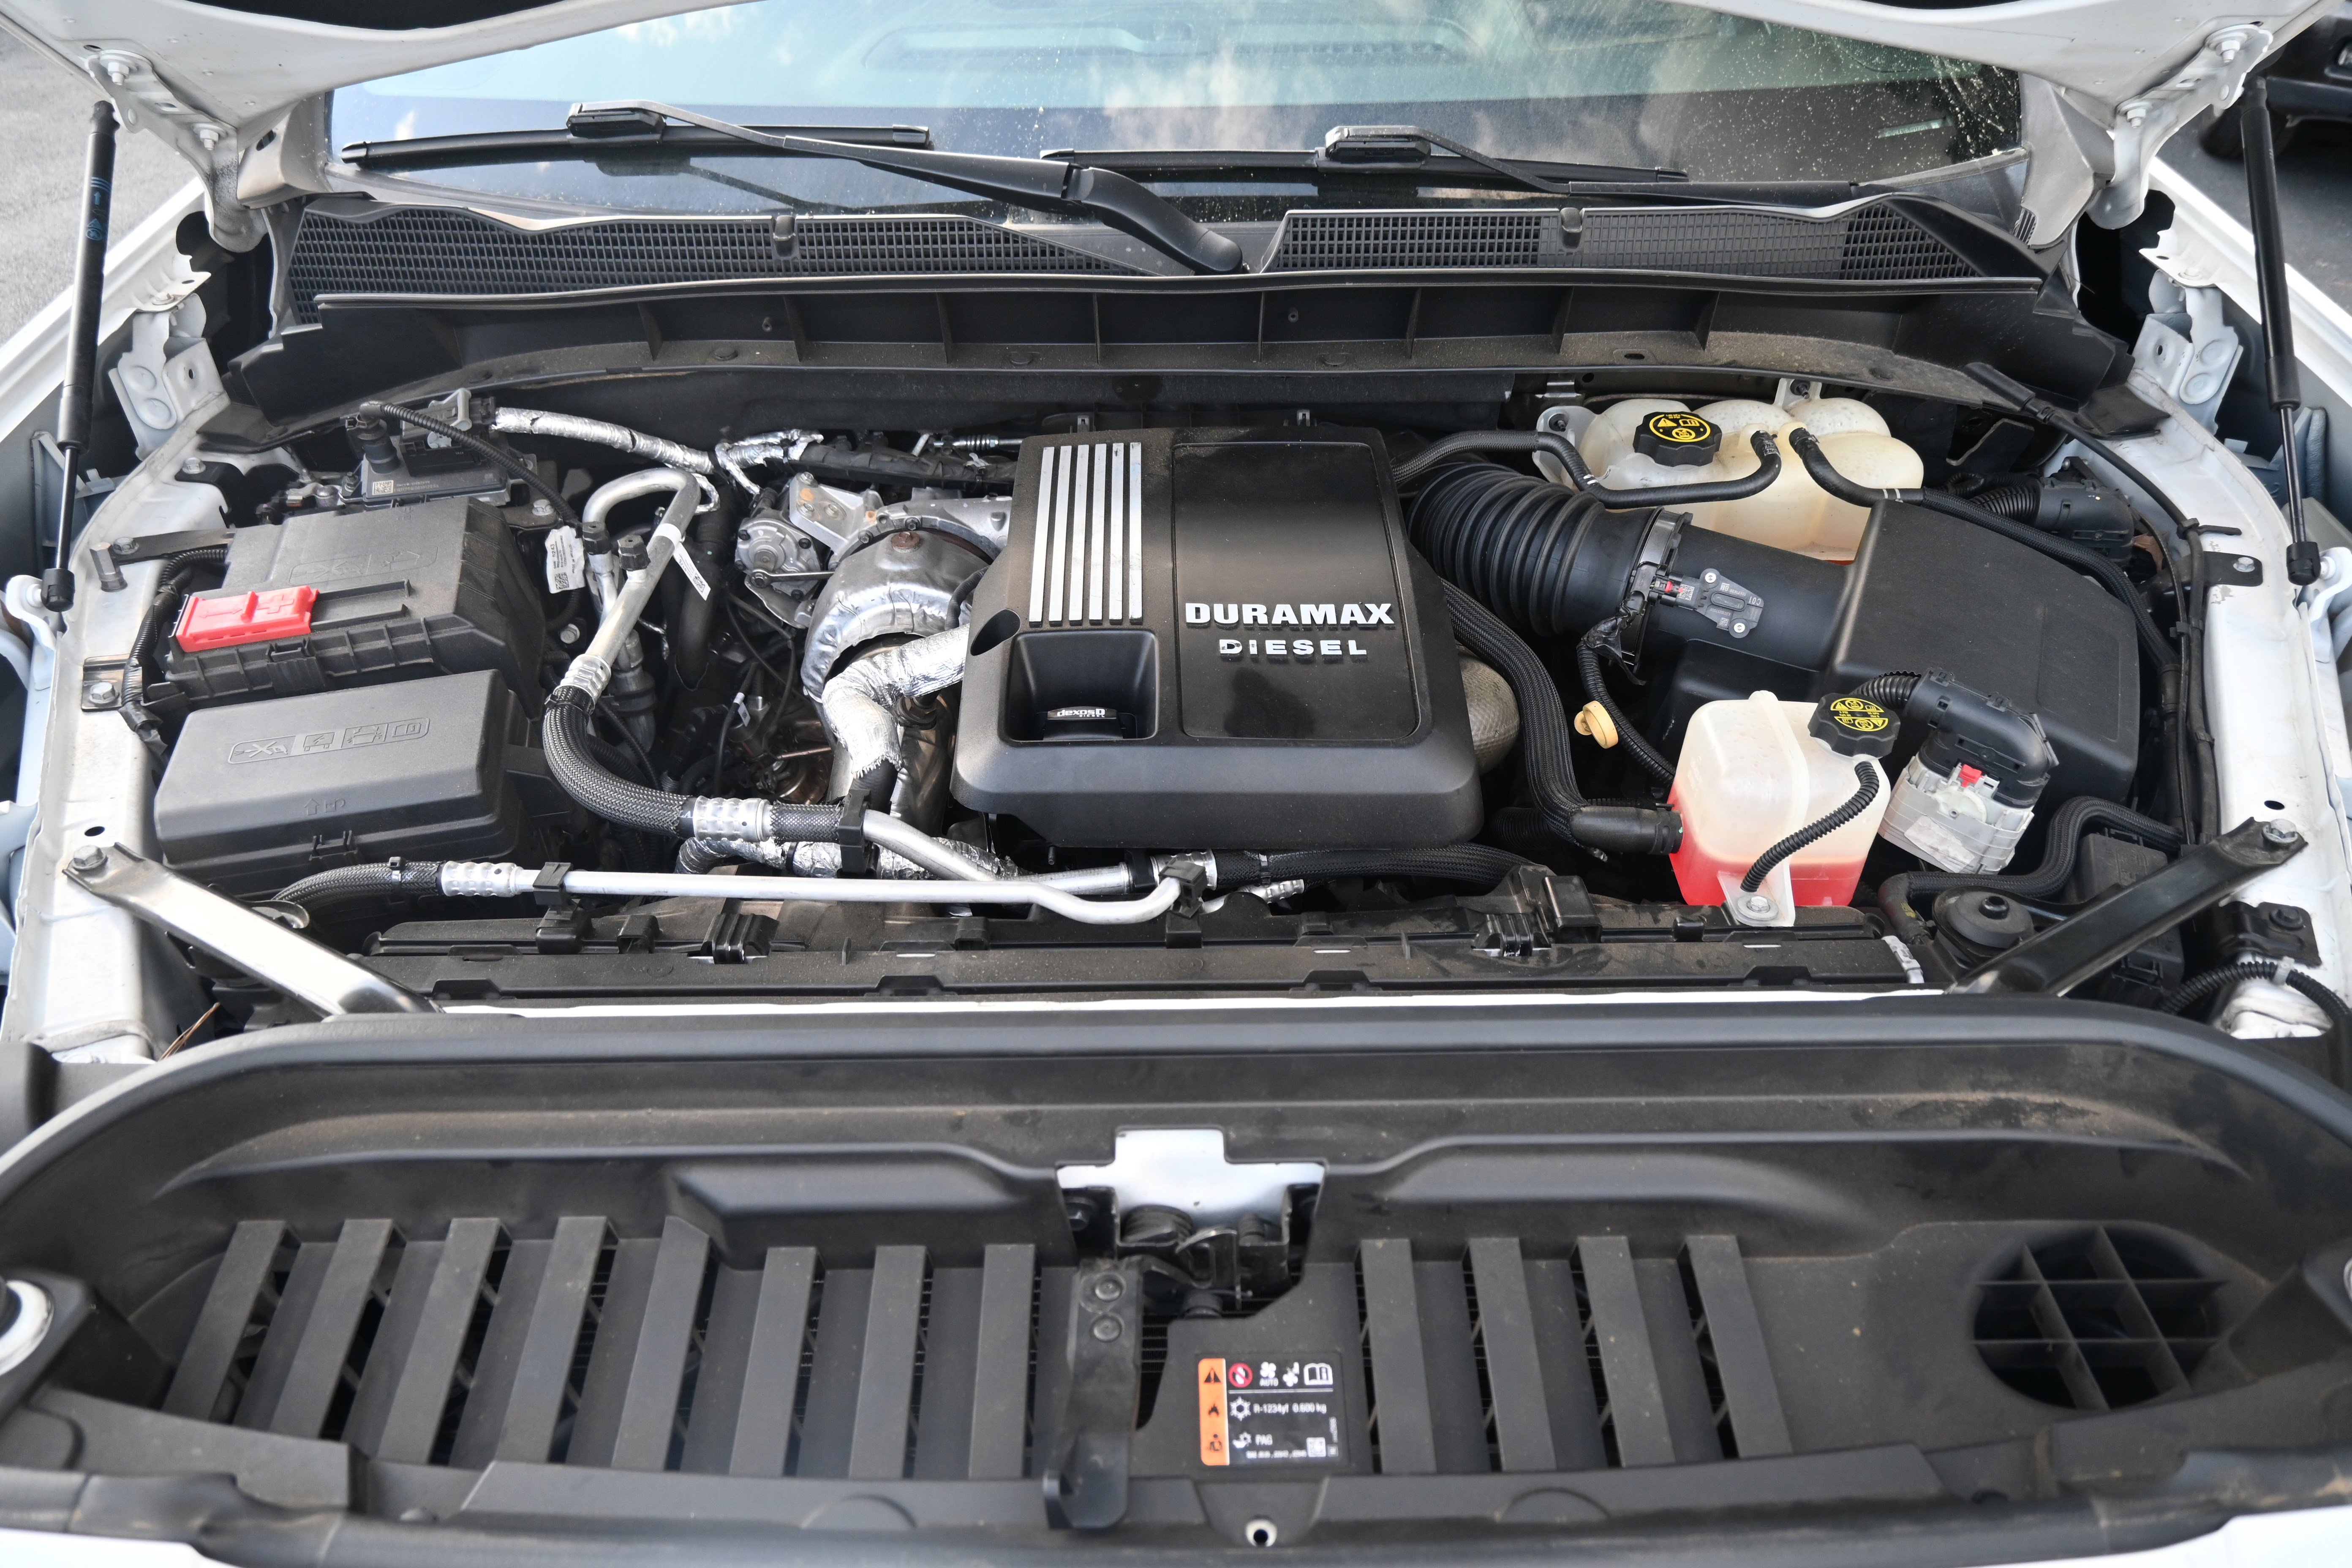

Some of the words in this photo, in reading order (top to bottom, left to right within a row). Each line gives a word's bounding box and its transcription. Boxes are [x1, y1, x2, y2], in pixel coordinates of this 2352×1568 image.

[1185, 603, 1394, 626] DURAMAX
[1220, 639, 1367, 656] DIESEL
[1260, 1378, 1278, 1386] AUTO
